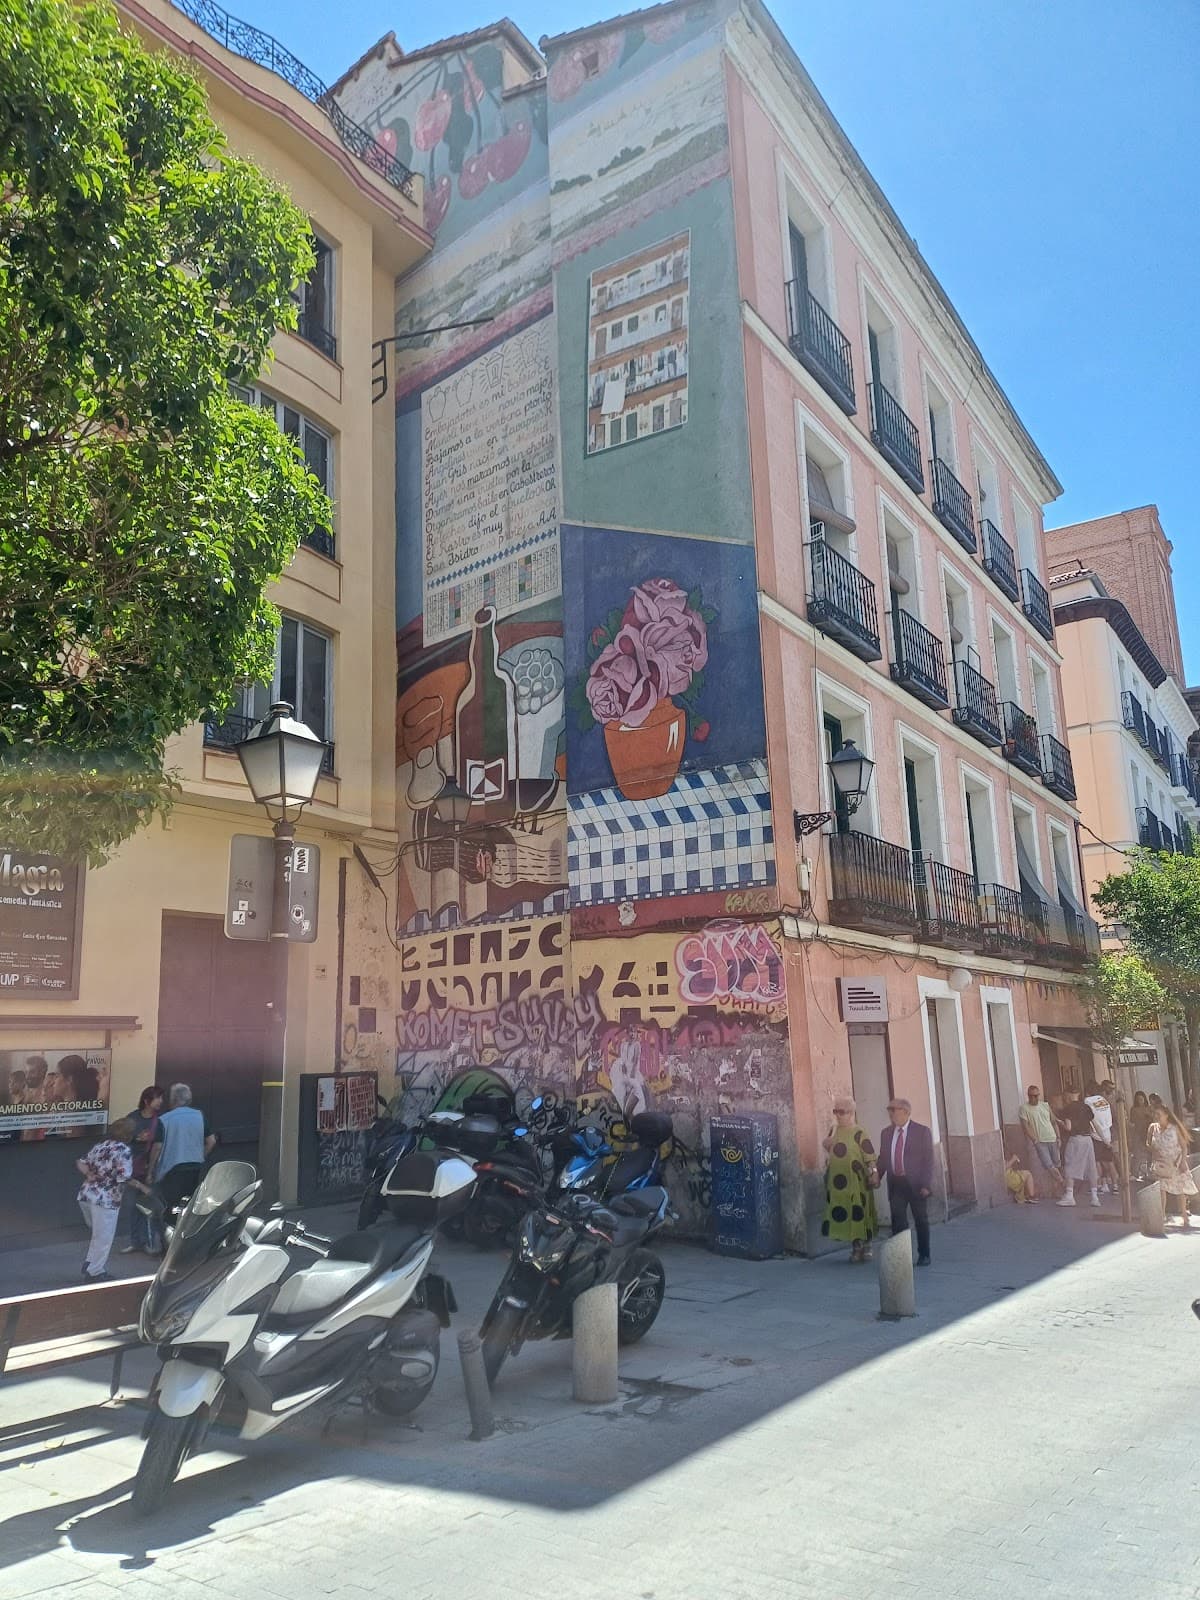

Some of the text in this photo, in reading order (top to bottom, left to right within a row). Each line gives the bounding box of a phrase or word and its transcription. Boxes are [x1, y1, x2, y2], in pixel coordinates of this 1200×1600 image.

[425, 439, 463, 468] Bajamos
[447, 464, 467, 484] Gris
[456, 490, 475, 505] una
[467, 513, 486, 529] dijo
[482, 522, 503, 535] muy
[447, 546, 478, 565] Isidro
[50, 1100, 103, 1112] ACTORALES
